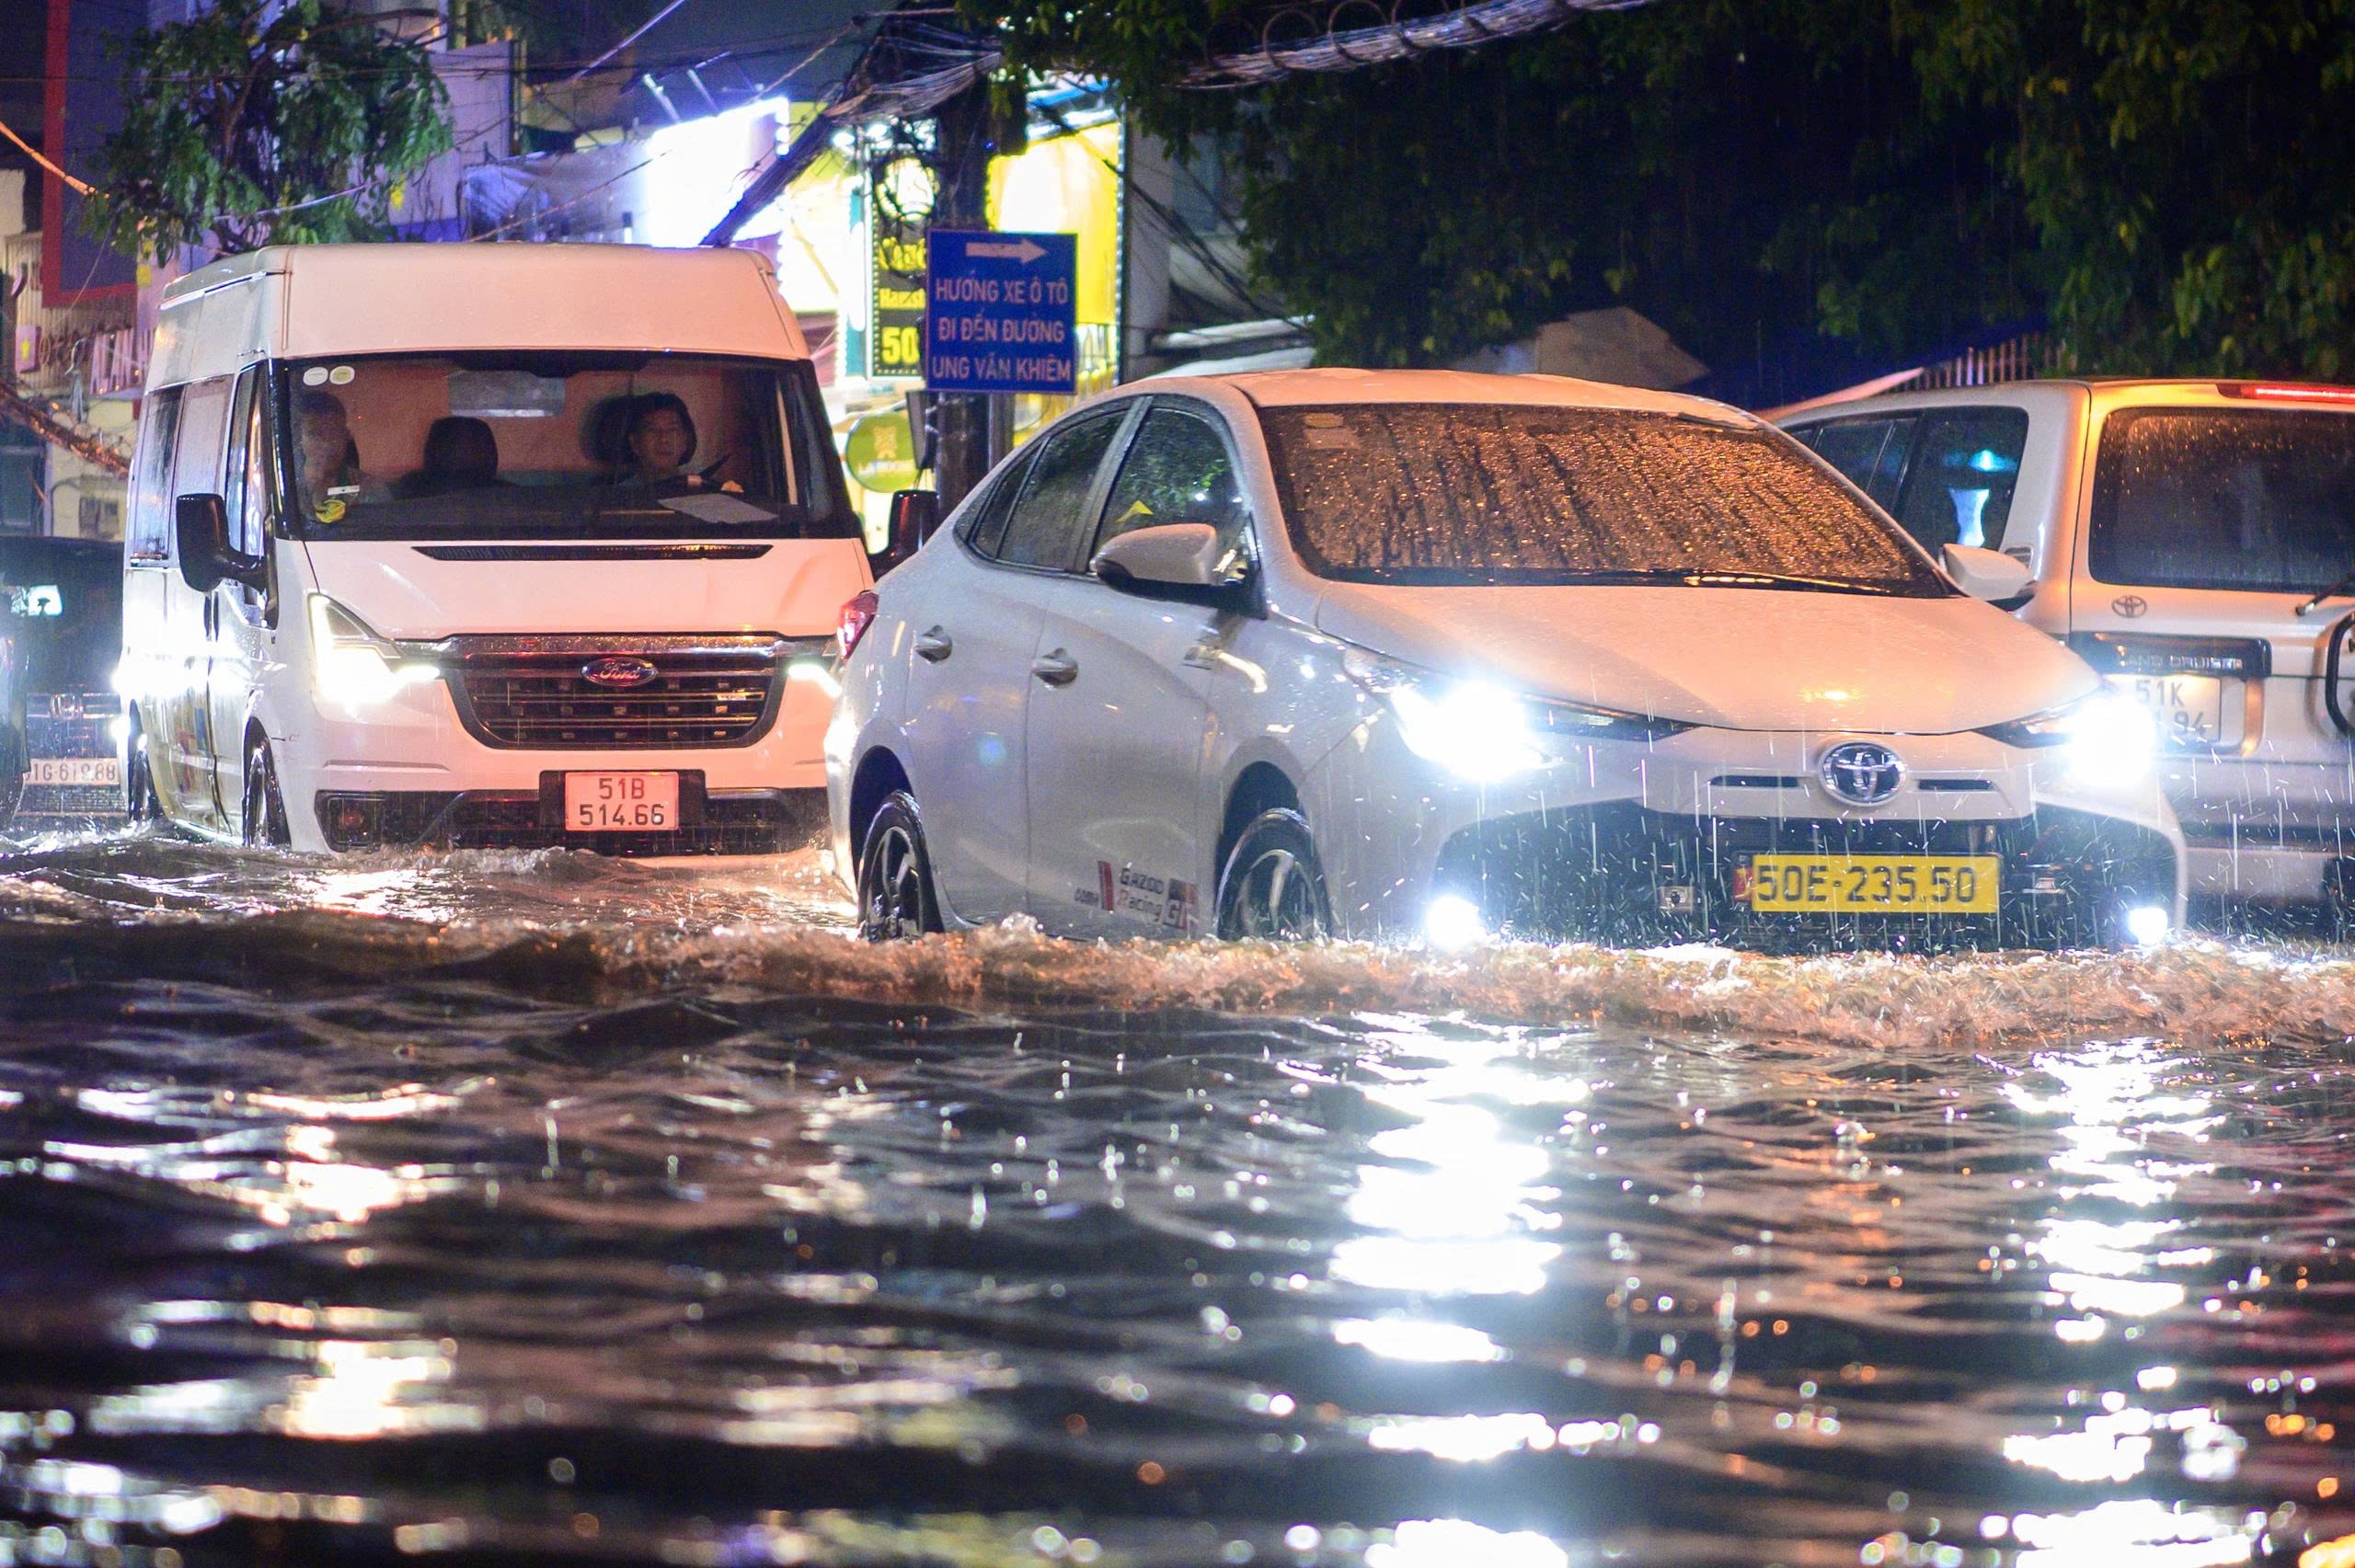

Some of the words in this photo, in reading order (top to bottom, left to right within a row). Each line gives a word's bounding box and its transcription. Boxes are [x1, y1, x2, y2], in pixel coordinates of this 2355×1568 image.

[935, 269, 999, 302] HƯỚNG
[1004, 280, 1026, 303] XE
[1029, 276, 1042, 303] Ô
[1046, 277, 1069, 304] TÔ
[938, 316, 956, 341] ĐI
[960, 308, 998, 341] ĐẾN
[1002, 312, 1064, 343] ĐƯỜNG
[932, 357, 971, 379] UNG
[973, 352, 1011, 380] VĂN
[1016, 354, 1072, 381] KHIÊM
[599, 662, 641, 680] Ford
[2135, 679, 2186, 706] 51K
[599, 778, 644, 799] 51B
[580, 804, 664, 826] 514.66
[1757, 865, 1975, 902] 50E-235.50
